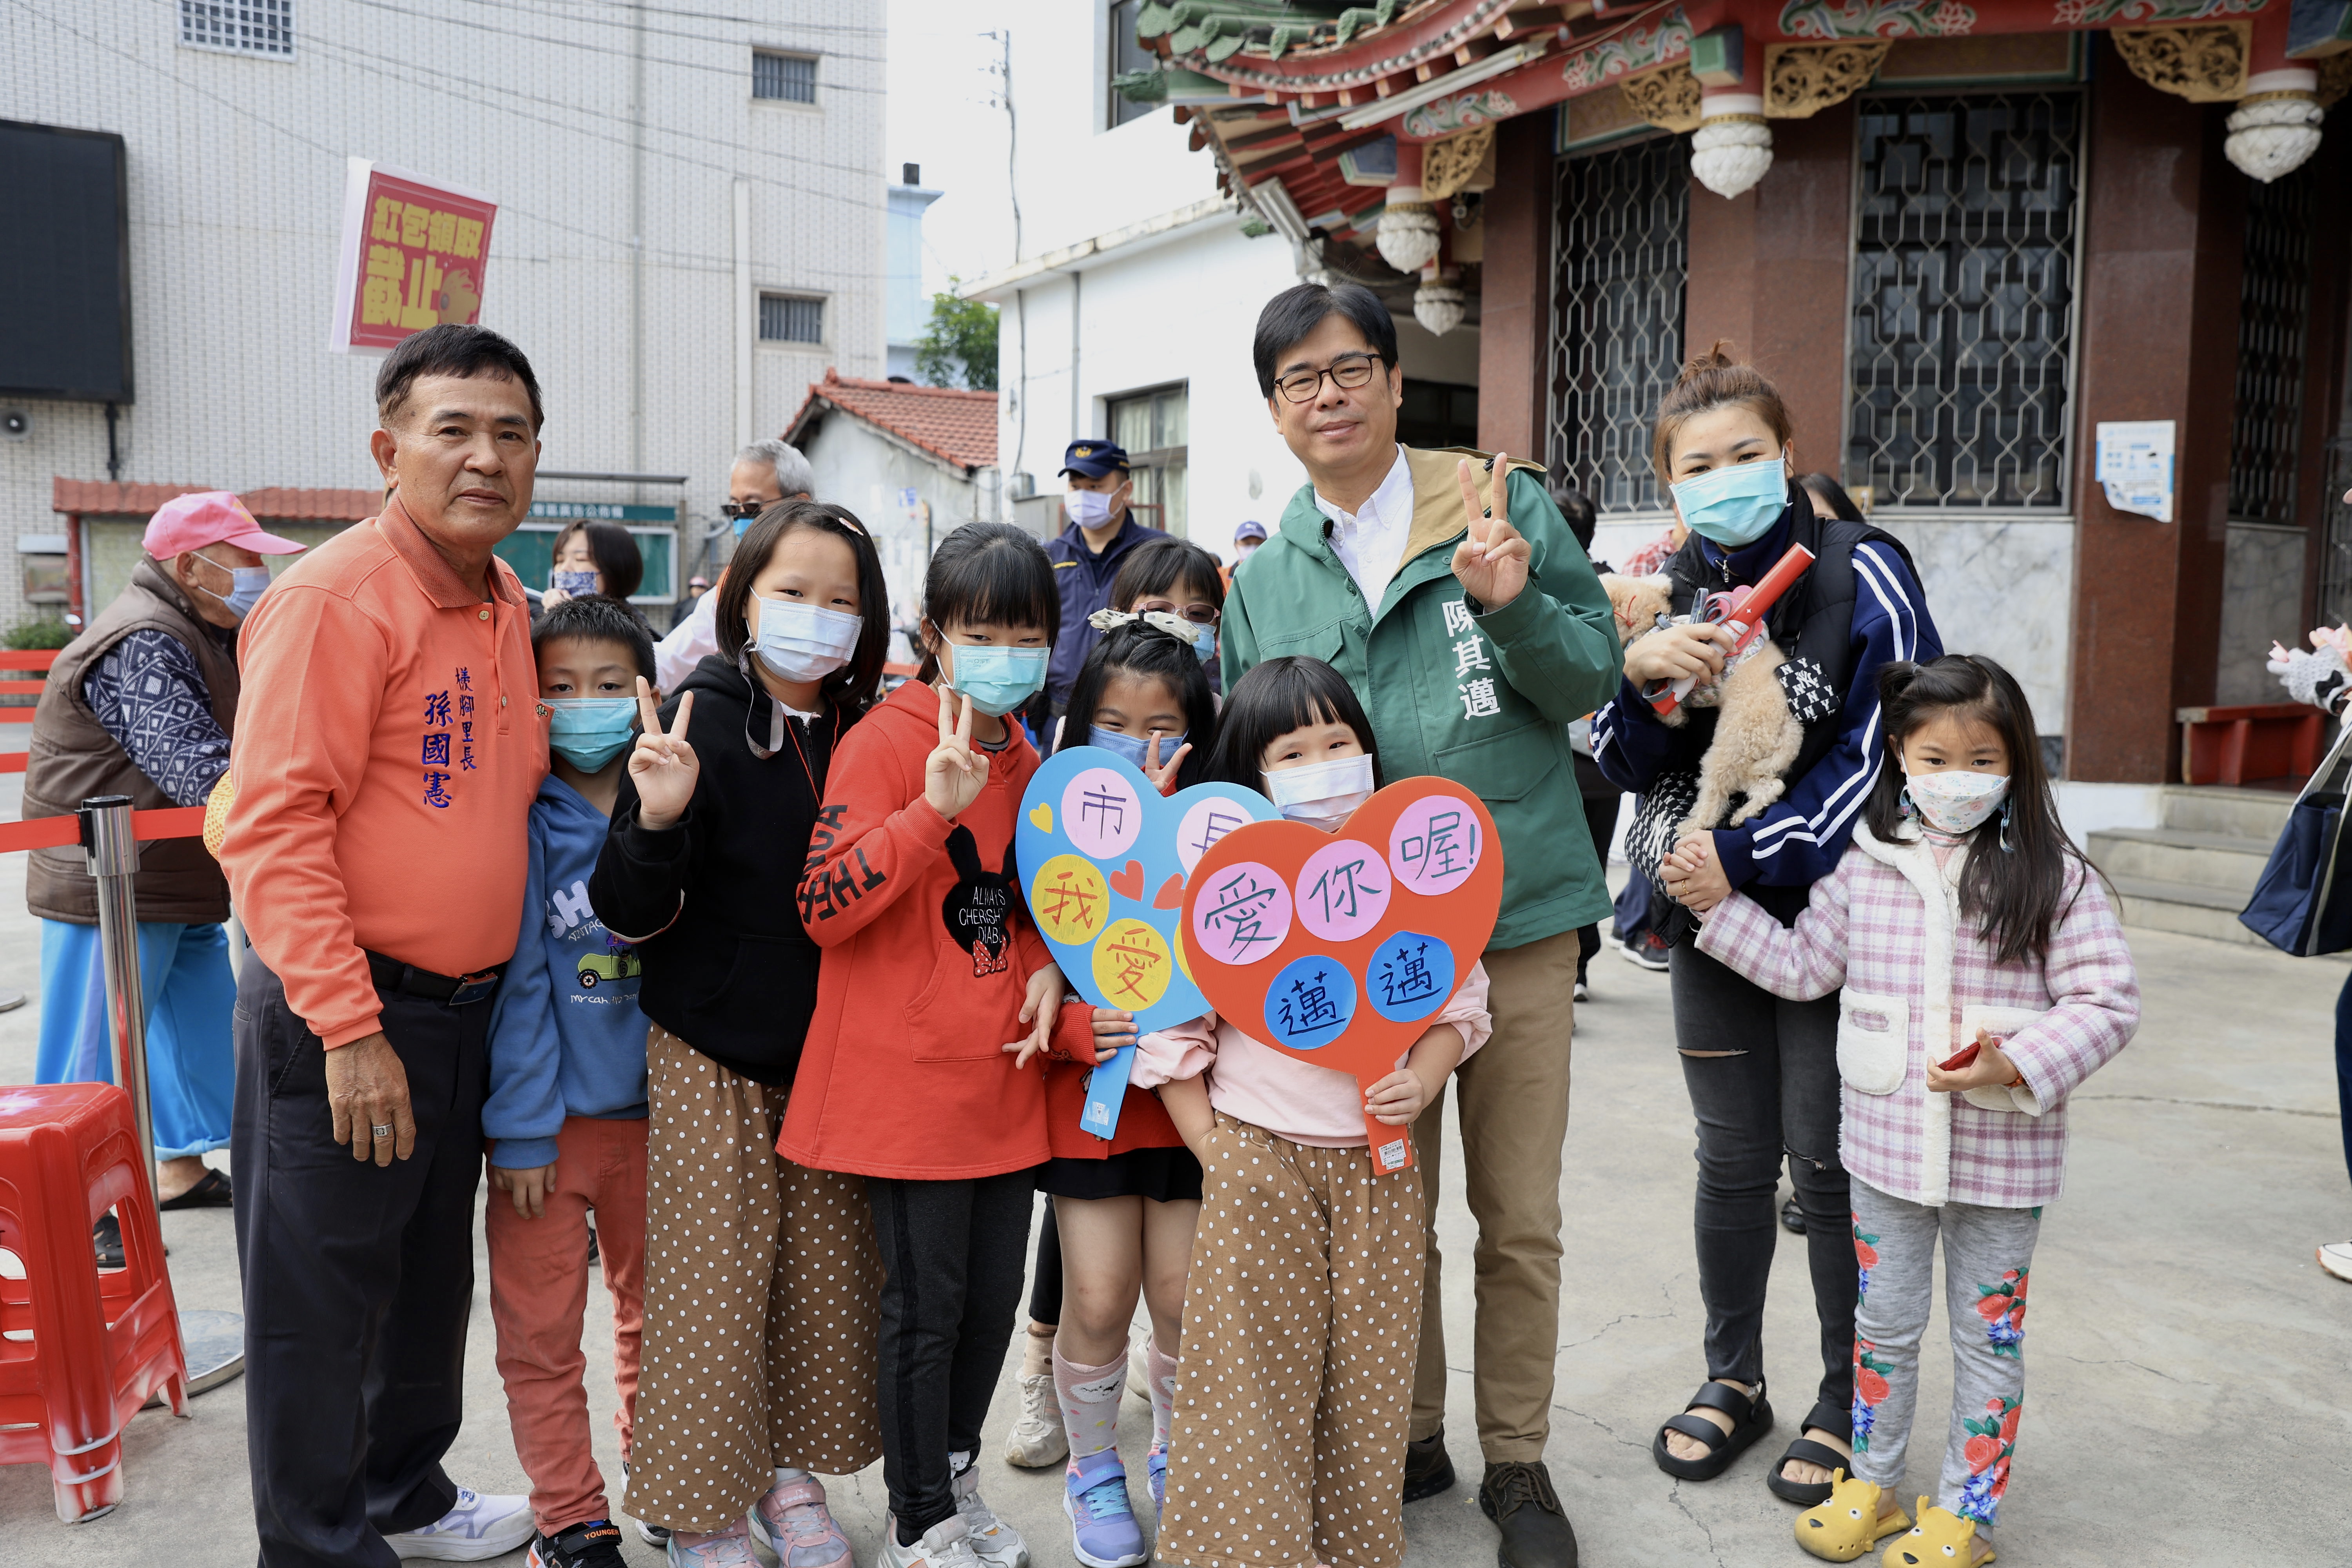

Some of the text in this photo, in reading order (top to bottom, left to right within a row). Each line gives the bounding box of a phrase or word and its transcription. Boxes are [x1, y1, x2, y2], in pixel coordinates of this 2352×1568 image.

[371, 195, 484, 260] 紅包領取
[362, 244, 443, 330] 截止
[528, 503, 624, 519] 樹區廣告公佈欄
[1441, 597, 1501, 720] 陳其邁
[421, 690, 454, 808] 孫國憲
[1644, 810, 1673, 864] NY
[973, 886, 1005, 905] ALWAYS
[619, 964, 627, 974] 16
[1278, 942, 1444, 1036] 邁邁
[584, 1529, 619, 1540] YOUNGER
